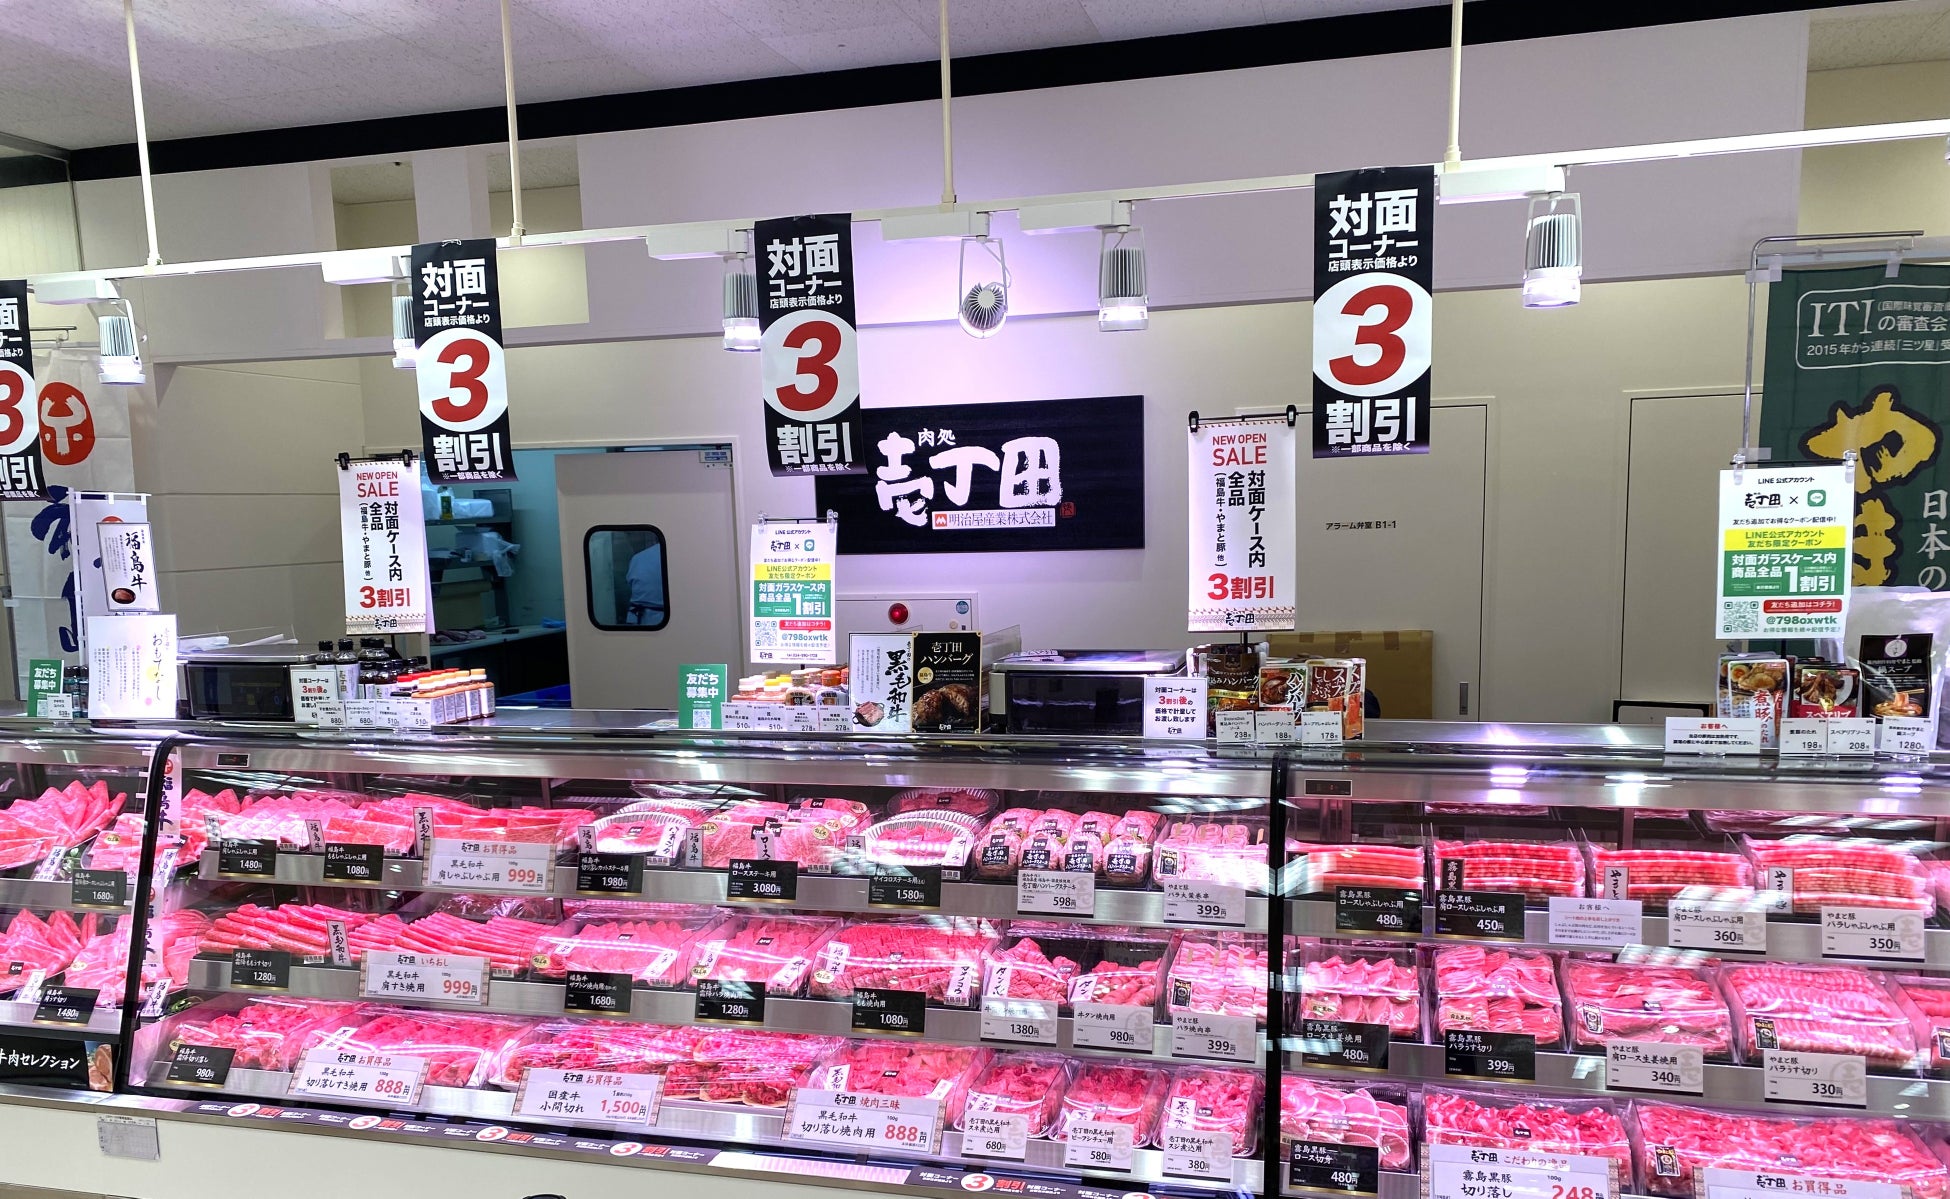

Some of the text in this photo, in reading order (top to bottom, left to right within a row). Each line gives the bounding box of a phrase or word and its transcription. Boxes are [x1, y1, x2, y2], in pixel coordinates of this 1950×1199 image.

[1329, 188, 1418, 238] 対面
[1329, 235, 1419, 259] コーナー
[767, 233, 840, 278] 対面
[1328, 255, 1418, 272] 店頭表示価格より
[421, 258, 487, 299] 対面
[769, 275, 842, 297] コーナー
[424, 296, 490, 317] コーナー
[769, 293, 843, 309] 店頭表示価格より
[424, 314, 490, 327] 店頭表示価格より
[1807, 300, 1873, 338] ITI
[1878, 316, 1948, 333] の審査会
[1329, 284, 1413, 386] 3
[776, 320, 842, 412] 3
[431, 338, 491, 423] 3
[1326, 397, 1416, 445] 割引
[776, 422, 853, 465] 割引
[918, 428, 956, 446] 肉処
[1212, 433, 1267, 446] NEW OPEN
[433, 432, 504, 473] 割引
[1212, 446, 1268, 467] SALE
[356, 472, 398, 481] NEW OPEN
[875, 431, 1062, 527] 壱丁田
[1776, 476, 1815, 484] 公式アカウント
[357, 481, 399, 498] SALE
[1228, 471, 1246, 507] 全品
[369, 502, 384, 531] 全品
[949, 510, 1053, 527] 明治屋産業株式会社
[1248, 470, 1266, 568] 対面ケース内
[1375, 520, 1397, 529] B1-1
[384, 501, 403, 581] 対面ケース内
[1745, 530, 1825, 539] LINE公式アカウント
[1747, 539, 1822, 548] 友だち限定クーポン
[125, 531, 148, 593] 福島牛
[1731, 553, 1837, 565] 対面ガラスケース内
[1731, 566, 1783, 579] 商品全品
[758, 583, 826, 593] 対面ガラスケース内
[1207, 573, 1275, 601] 3割引
[359, 586, 411, 608] 3割引
[758, 592, 792, 603] 商品全品
[1770, 601, 1836, 609] 友だち追加はコチラ!
[1766, 616, 1838, 625] @798oxwtk
[781, 633, 828, 641] @798oxwtk
[931, 641, 962, 653] 壱丁田
[919, 653, 974, 665] ハンバーグ
[34, 667, 57, 678] 友だち
[686, 673, 719, 684] 友だち
[33, 679, 57, 691] 募集中
[884, 649, 912, 723] 黒毛和牛
[686, 686, 719, 699] 募集中
[1158, 695, 1193, 706] 3割引後の
[1154, 708, 1196, 716] 価格で計量して
[1154, 715, 1197, 723] お渡し致します
[483, 843, 517, 855] お買得品
[450, 858, 485, 869] 黒毛和牛
[731, 862, 752, 870] 福島牛
[438, 869, 500, 883] 肩しゃぶしゃぶ用
[731, 870, 777, 878] ロースステーキ用
[1339, 899, 1404, 909] ロースしゃぶしゃぶ用
[1439, 903, 1506, 914] 肩ロースしゃぶしゃぶ用
[1674, 913, 1744, 925] 肩ロースしゃぶしゃぶ用
[1826, 920, 1896, 932] バラしゃぶしゃぶ用
[420, 957, 449, 967] いちおし
[386, 970, 420, 981] 黒毛和牛
[381, 981, 426, 993] 肩すき焼用
[856, 1000, 887, 1008] もも焼肉用
[1077, 1011, 1116, 1021] 牛タン焼肉用
[1448, 1033, 1482, 1044] 霧島黒豚
[1448, 1043, 1493, 1054] バラうす切り
[358, 1054, 392, 1067] お買得品
[1611, 1053, 1678, 1065] 肩ロース生姜焼用
[1769, 1056, 1799, 1065] やまと豚
[321, 1067, 355, 1078] 黒毛和牛
[1769, 1064, 1819, 1076] バラうす切り
[306, 1077, 369, 1092] 切り落しすき焼用
[585, 1074, 623, 1086] お買得品
[547, 1089, 581, 1101] 国産牛
[539, 1101, 585, 1115] 小間切れ
[817, 1109, 858, 1122] 黒毛和牛
[800, 1122, 876, 1139] 切り落し焼肉用
[1071, 1134, 1114, 1145] ビーフシチュー用
[1168, 1142, 1203, 1153] スジ煮込用
[1294, 1153, 1334, 1165] ロース切身
[1470, 1149, 1498, 1163] 壱丁田
[965, 1175, 988, 1190] 3
[1462, 1169, 1513, 1183] 霧島黒豚
[1756, 1174, 1848, 1195] 壱丁田 お買得品
[1460, 1184, 1514, 1199] 切り落し
